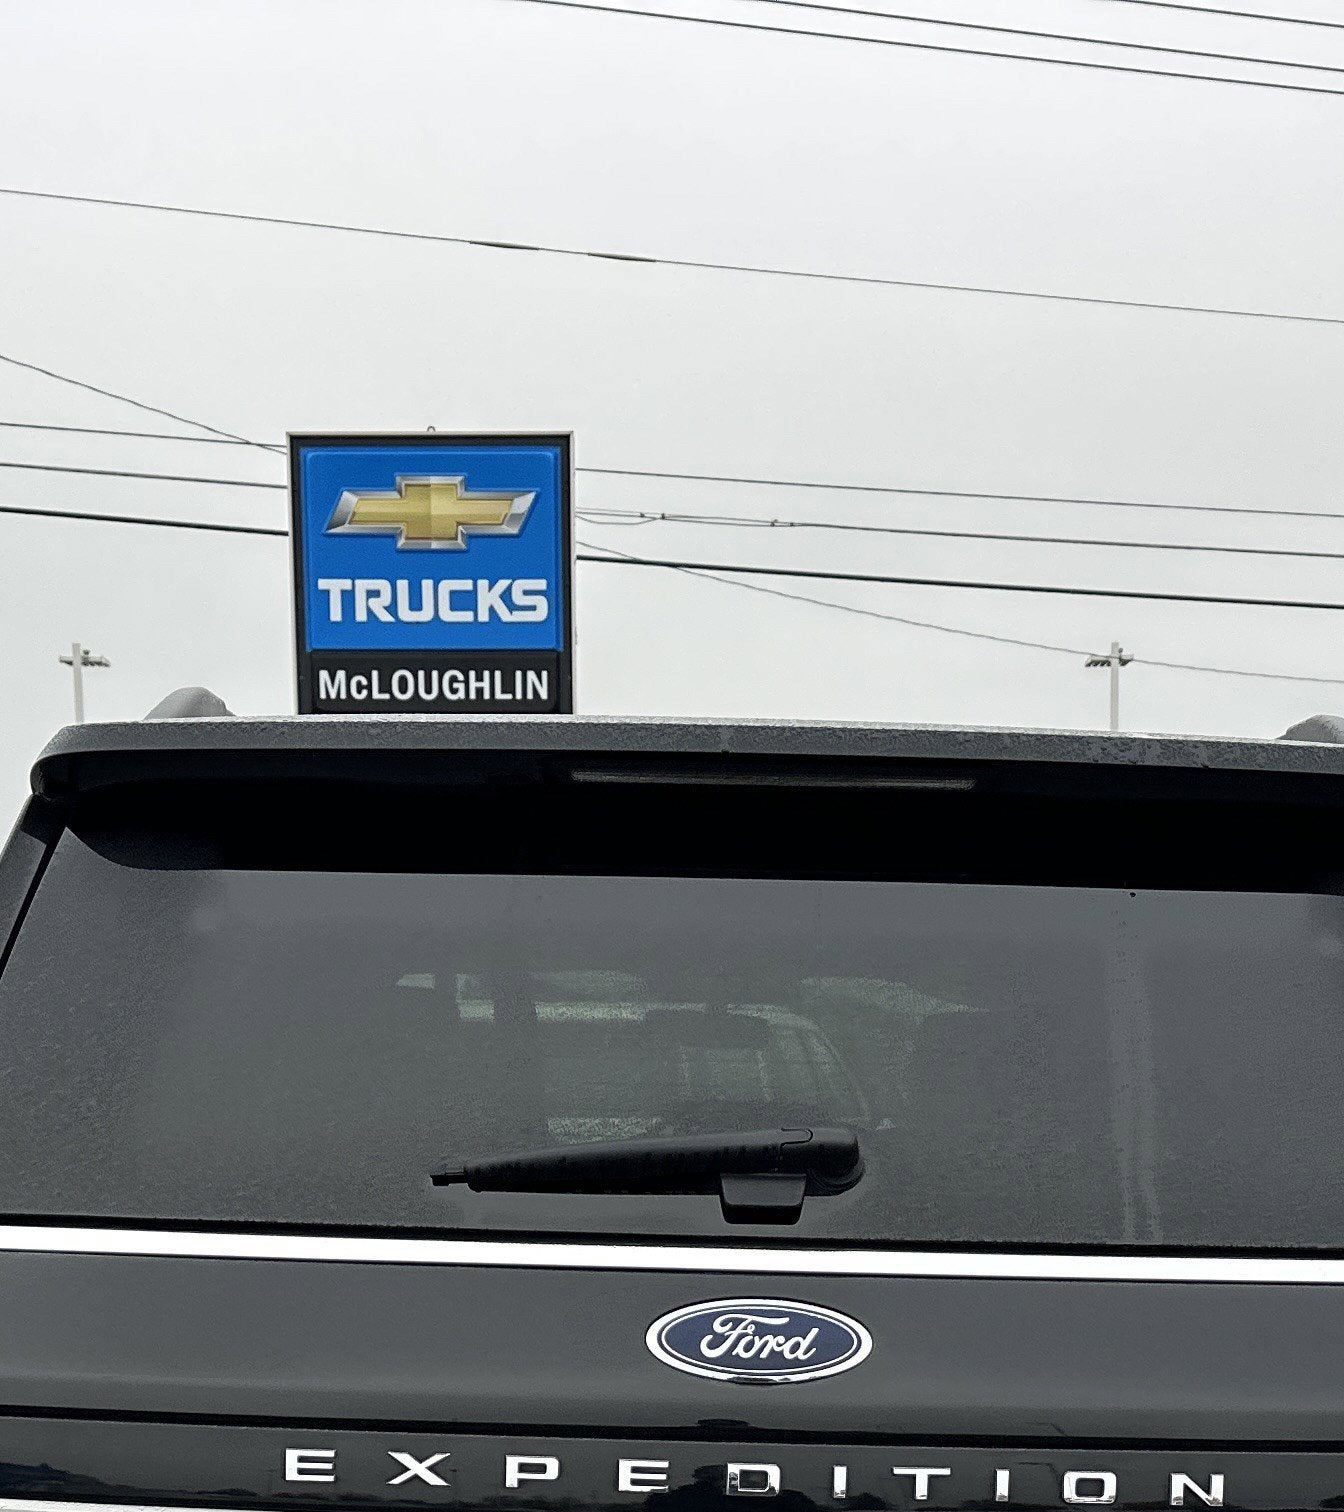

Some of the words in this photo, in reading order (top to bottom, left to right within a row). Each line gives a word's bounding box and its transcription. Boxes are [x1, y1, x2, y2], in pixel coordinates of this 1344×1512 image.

[317, 577, 549, 623] TRUCKS
[318, 668, 548, 701] McLOUGHLIN
[699, 1313, 820, 1361] Ford
[284, 1447, 1227, 1508] EXPEDITION
